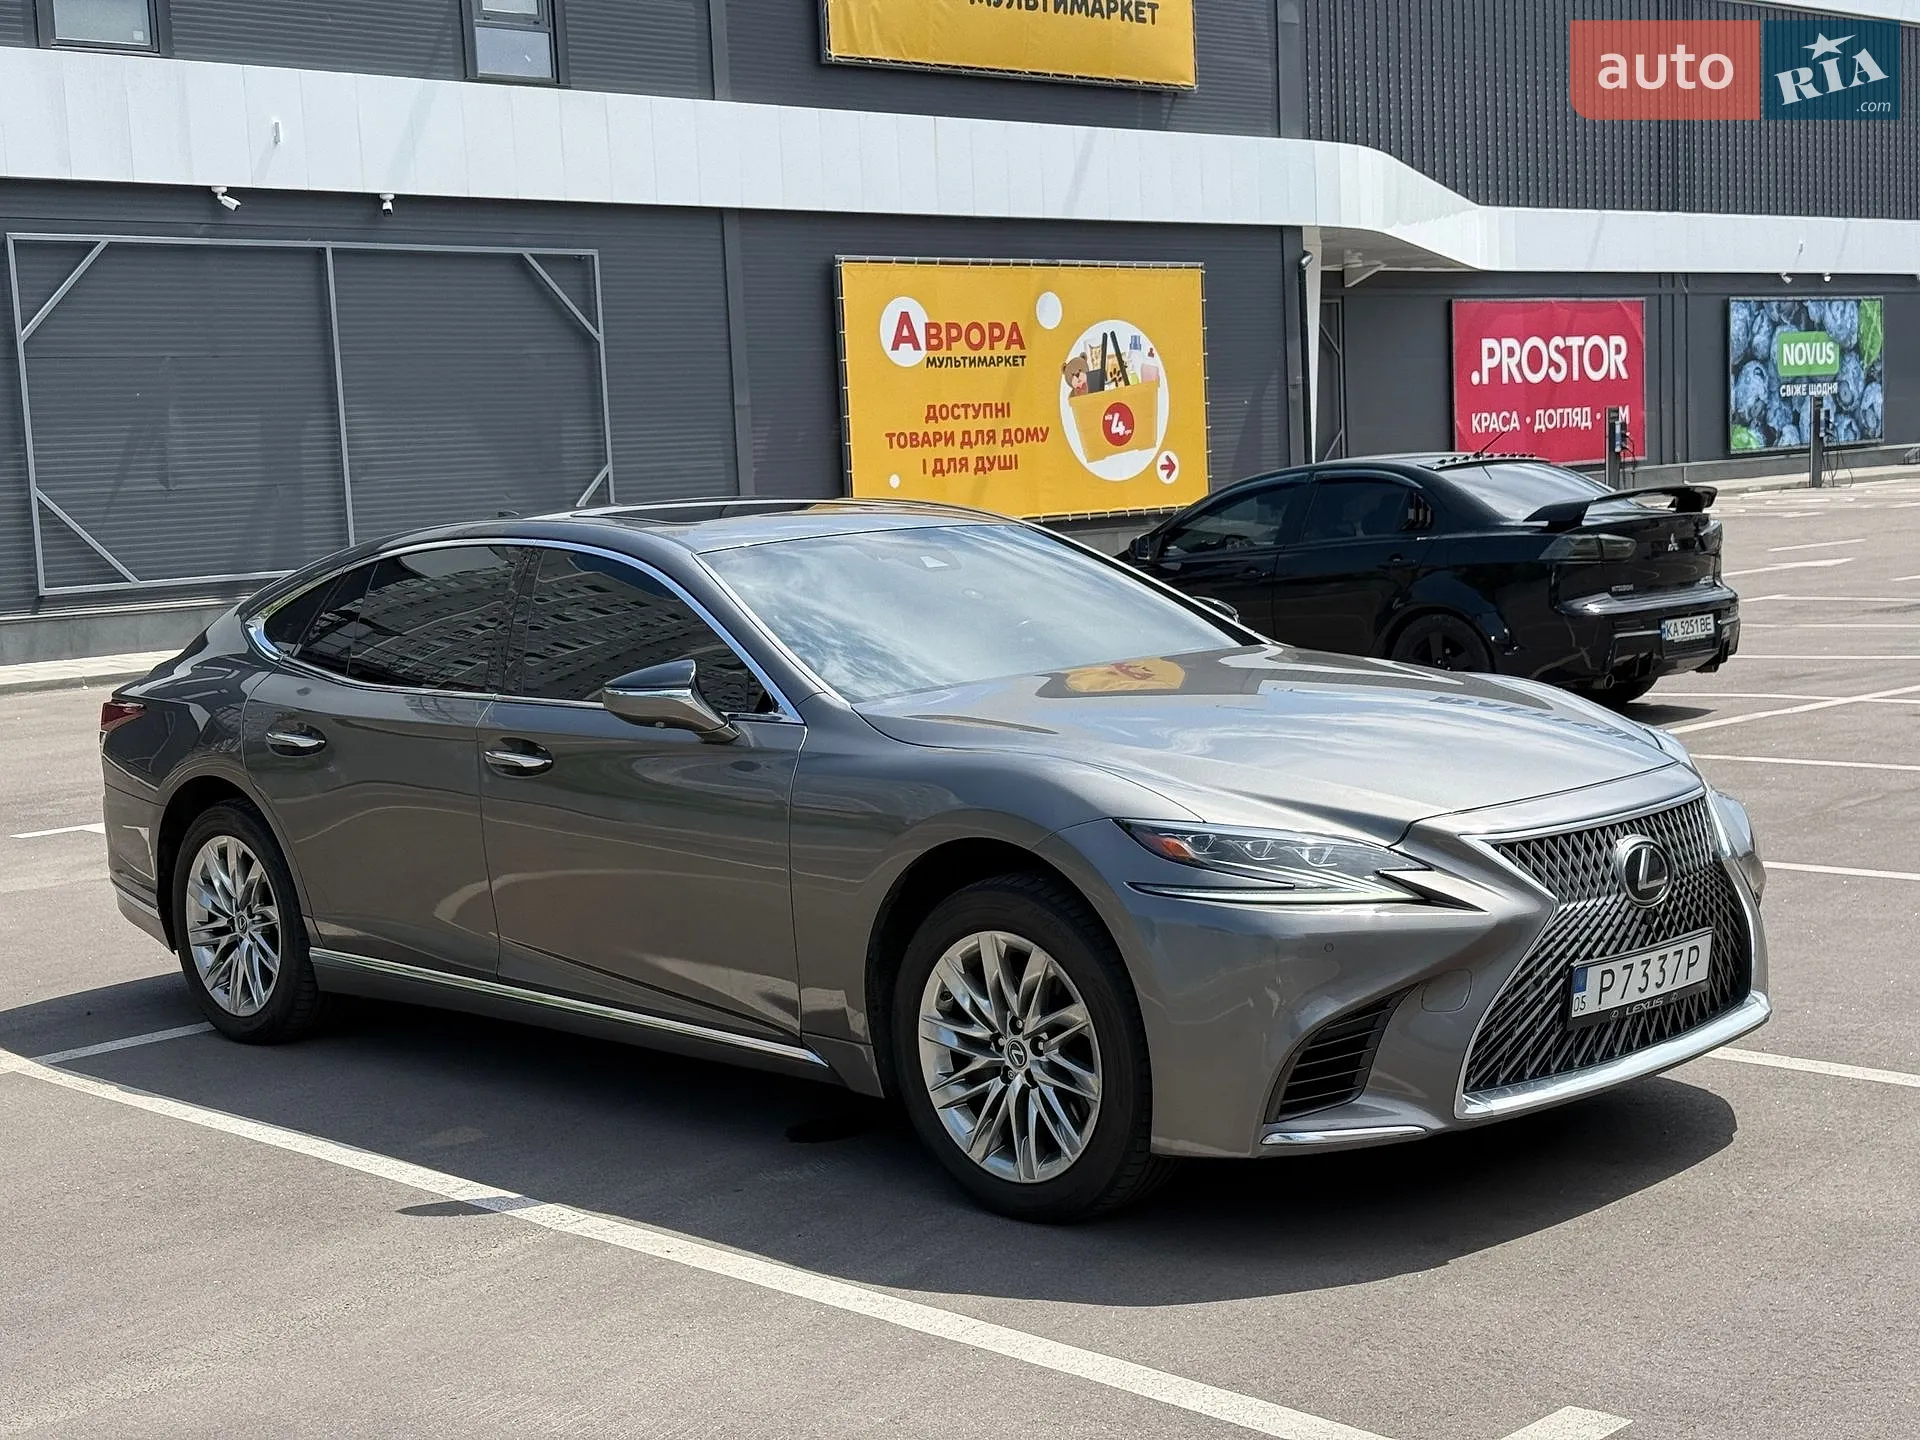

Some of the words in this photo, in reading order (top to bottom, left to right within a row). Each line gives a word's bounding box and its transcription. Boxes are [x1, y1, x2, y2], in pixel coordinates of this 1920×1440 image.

[968, 0, 1159, 25] ЬТИМАРКЕТ
[891, 311, 1026, 352] АВРОРА
[925, 354, 1027, 370] МУЛЬТИМАРКЕТ
[1782, 341, 1835, 367] NOVUS
[1780, 383, 1808, 398] СВІЖЕ
[1808, 382, 1839, 397] ЩОДНЯ
[924, 402, 1012, 425] ДОСТУПНІ
[1471, 409, 1521, 434] КРАСА
[1534, 406, 1593, 432] ДОГЛЯД
[885, 431, 955, 450] ТОВАРИ
[959, 430, 997, 449] ДЛЯ
[1001, 426, 1050, 447] ДОМУ
[932, 458, 969, 478] ДЛЯ
[974, 454, 1019, 476] ДУШІ
[1598, 944, 1701, 1006] P7337P
[1573, 995, 1587, 1012] 05
[1625, 997, 1664, 1016] LEXUS
